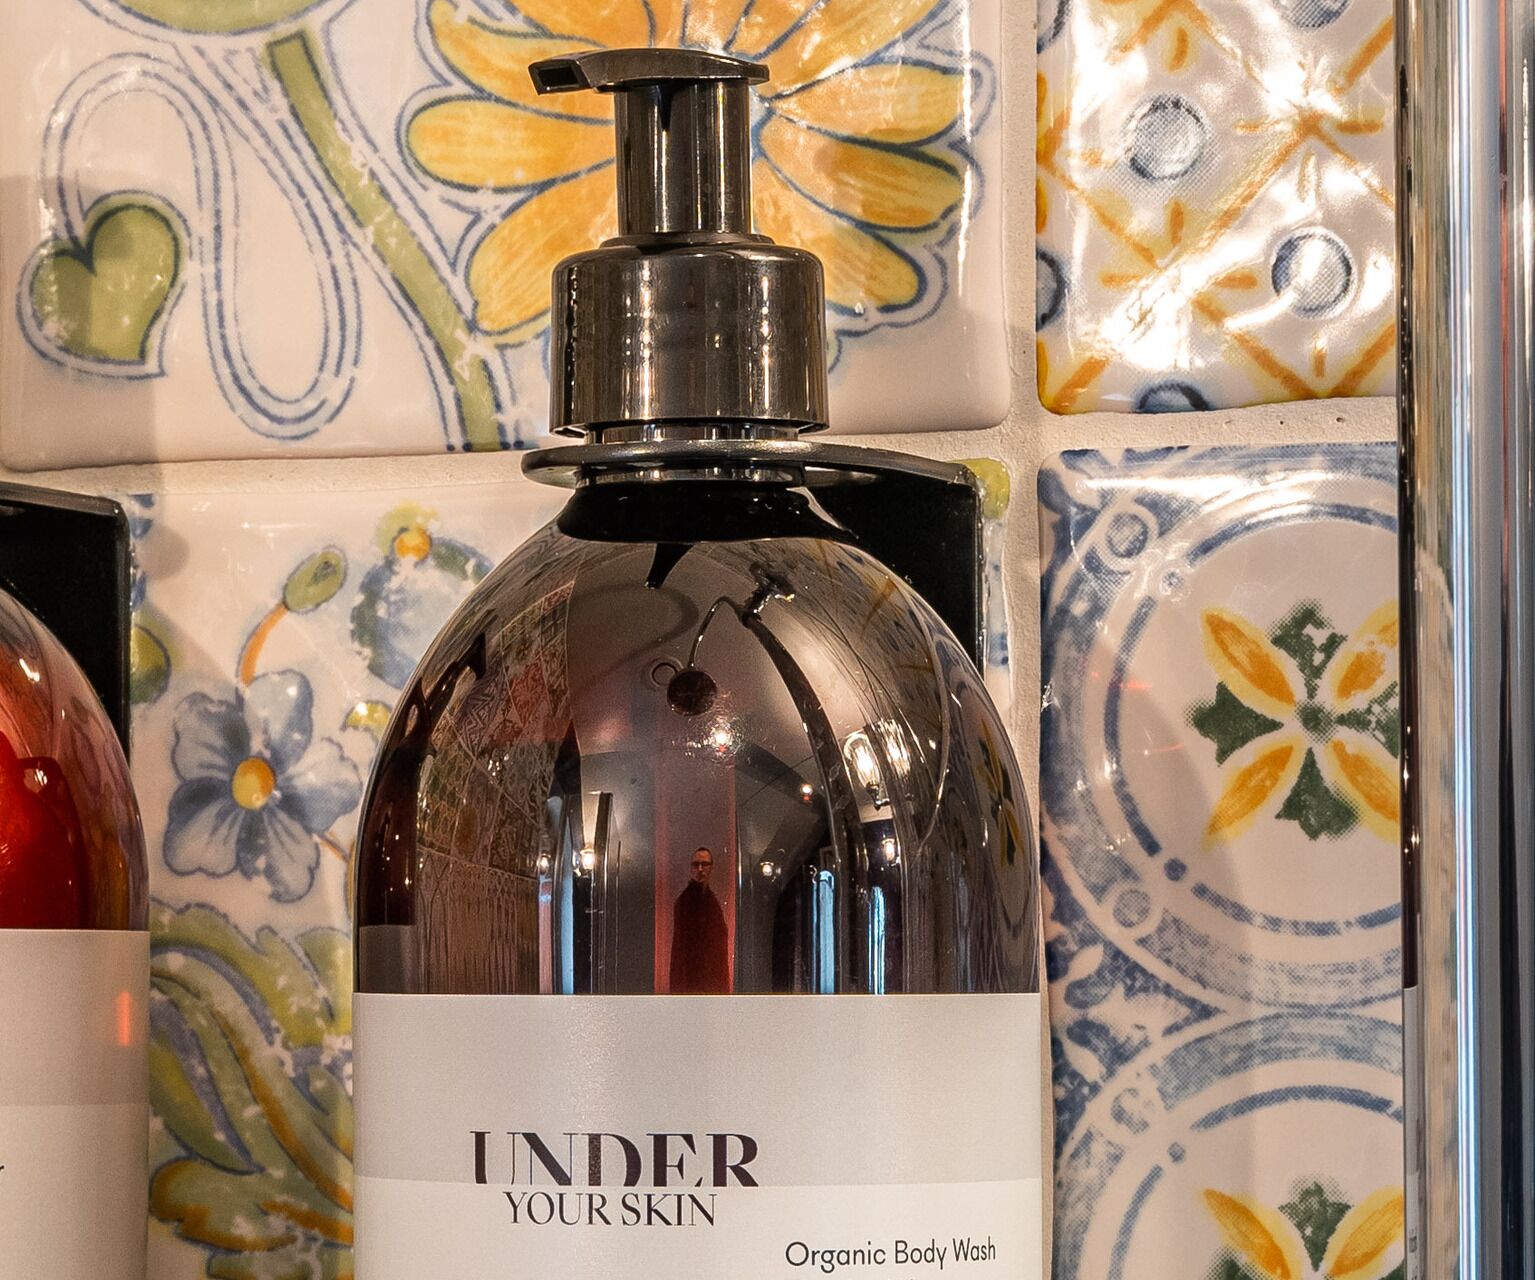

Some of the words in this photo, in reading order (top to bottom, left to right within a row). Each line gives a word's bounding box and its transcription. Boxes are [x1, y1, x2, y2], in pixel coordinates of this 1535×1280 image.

[469, 1131, 759, 1188] UNDER
[502, 1191, 612, 1226] YOUR
[621, 1192, 717, 1226] SKIN
[785, 1241, 886, 1274] Organic
[895, 1238, 947, 1270] Body
[952, 1236, 996, 1262] Wash
